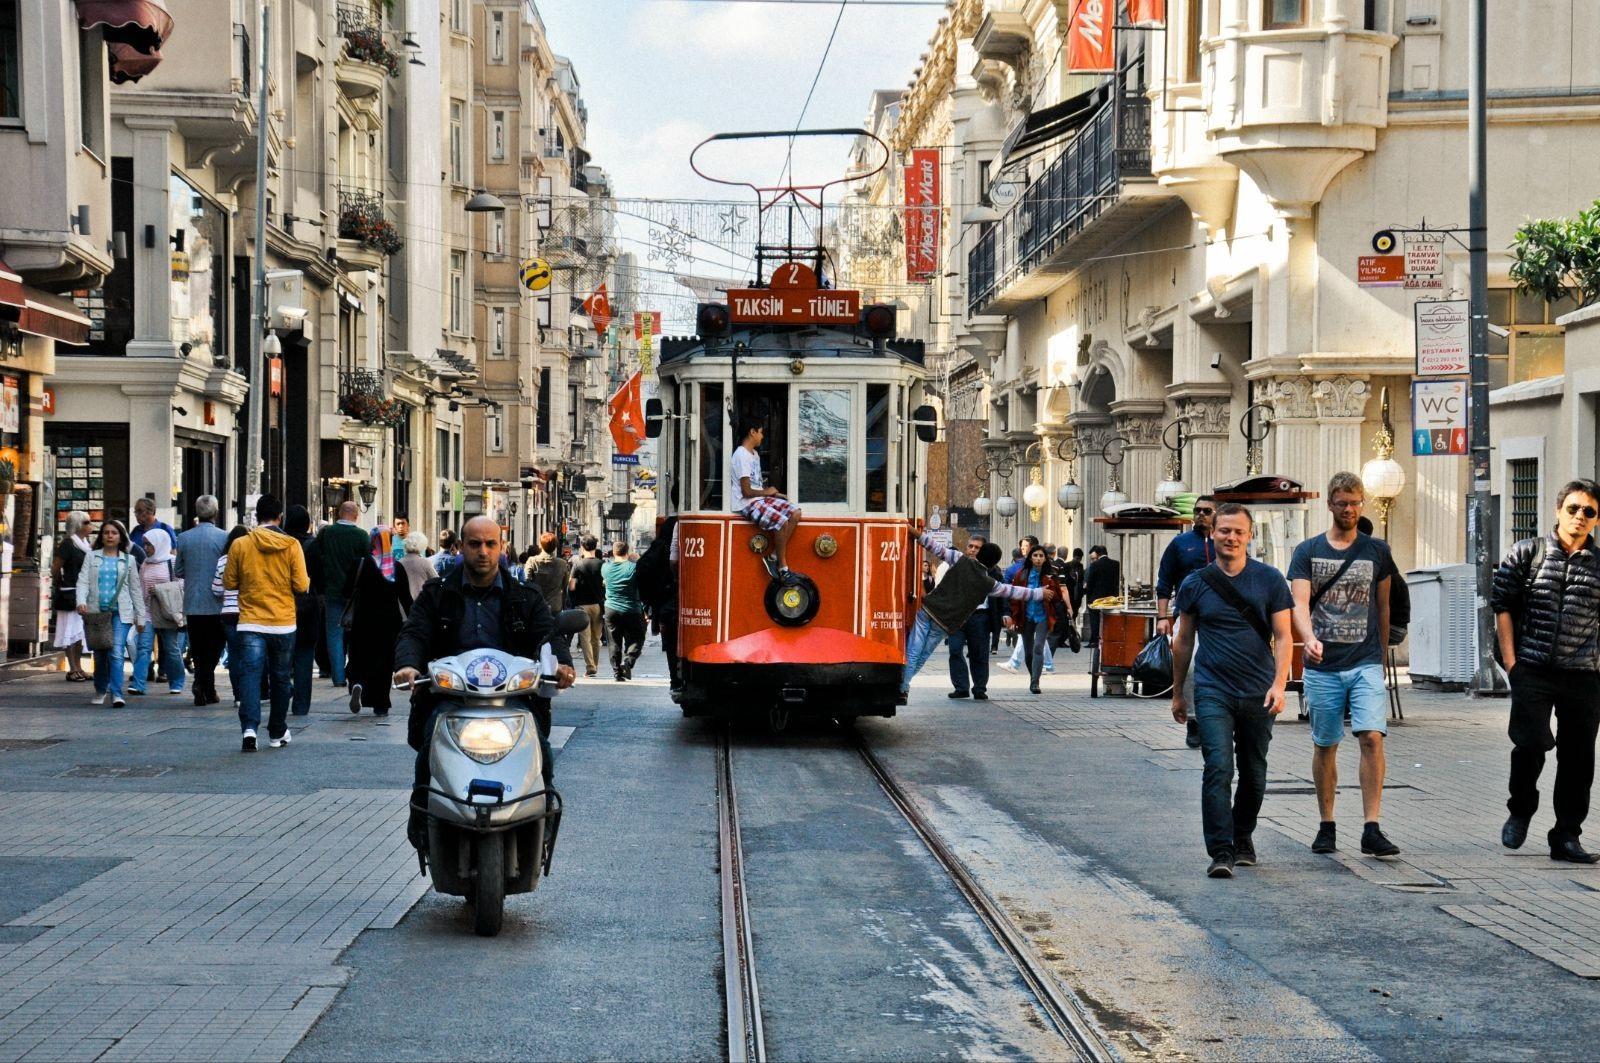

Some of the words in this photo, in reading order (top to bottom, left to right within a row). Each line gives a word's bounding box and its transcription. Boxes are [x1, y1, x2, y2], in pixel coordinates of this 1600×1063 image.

[919, 159, 934, 204] Markt
[789, 264, 799, 284] 2
[1360, 267, 1387, 275] YILMAZ
[735, 295, 784, 316] TAKSİM
[808, 296, 855, 317] TÜNEL
[1421, 396, 1458, 413] WC
[685, 537, 705, 558] 223
[881, 541, 900, 561] 223
